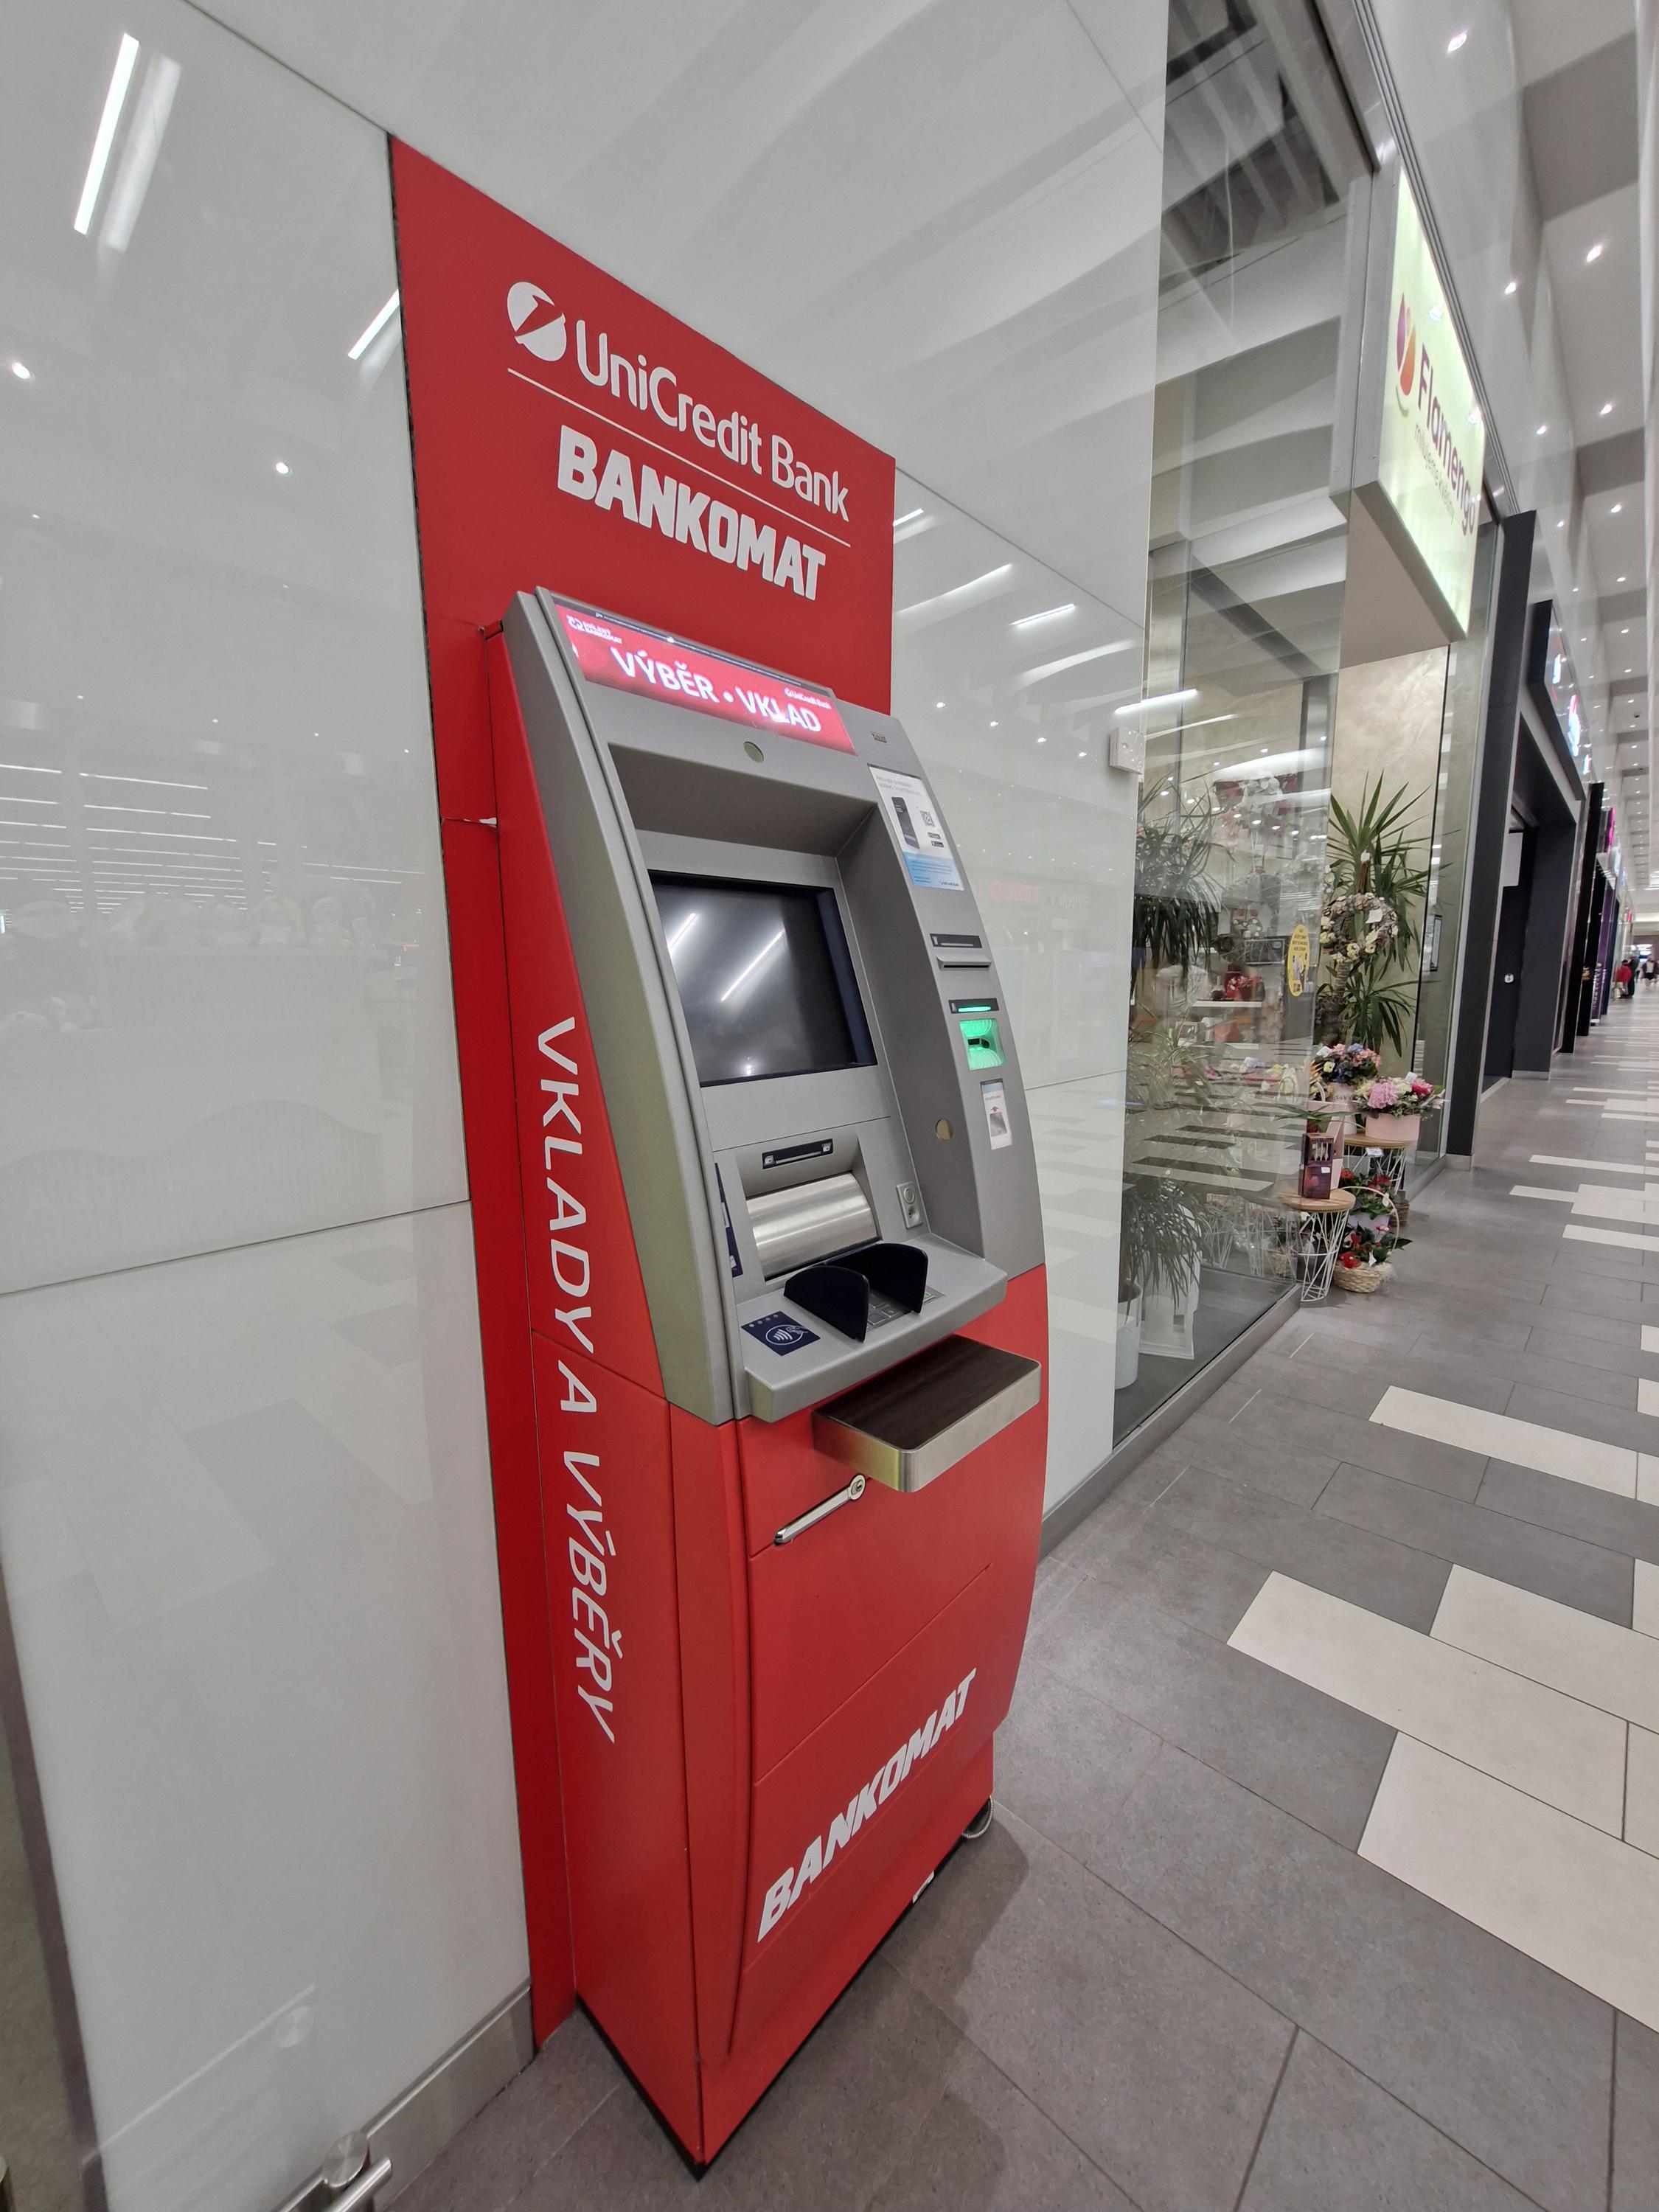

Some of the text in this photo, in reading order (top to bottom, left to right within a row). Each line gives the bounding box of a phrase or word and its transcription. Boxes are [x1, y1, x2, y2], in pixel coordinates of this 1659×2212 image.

[557, 425, 826, 601] BANKOMAT
[576, 320, 849, 522] UniCredit Bank
[1417, 343, 1475, 537] Flamengo
[610, 646, 822, 731] VÝBĚR VKLAD
[538, 1016, 623, 1745] VKLADY A VÝBĚRY
[757, 1666, 977, 1944] BANKOMAT
